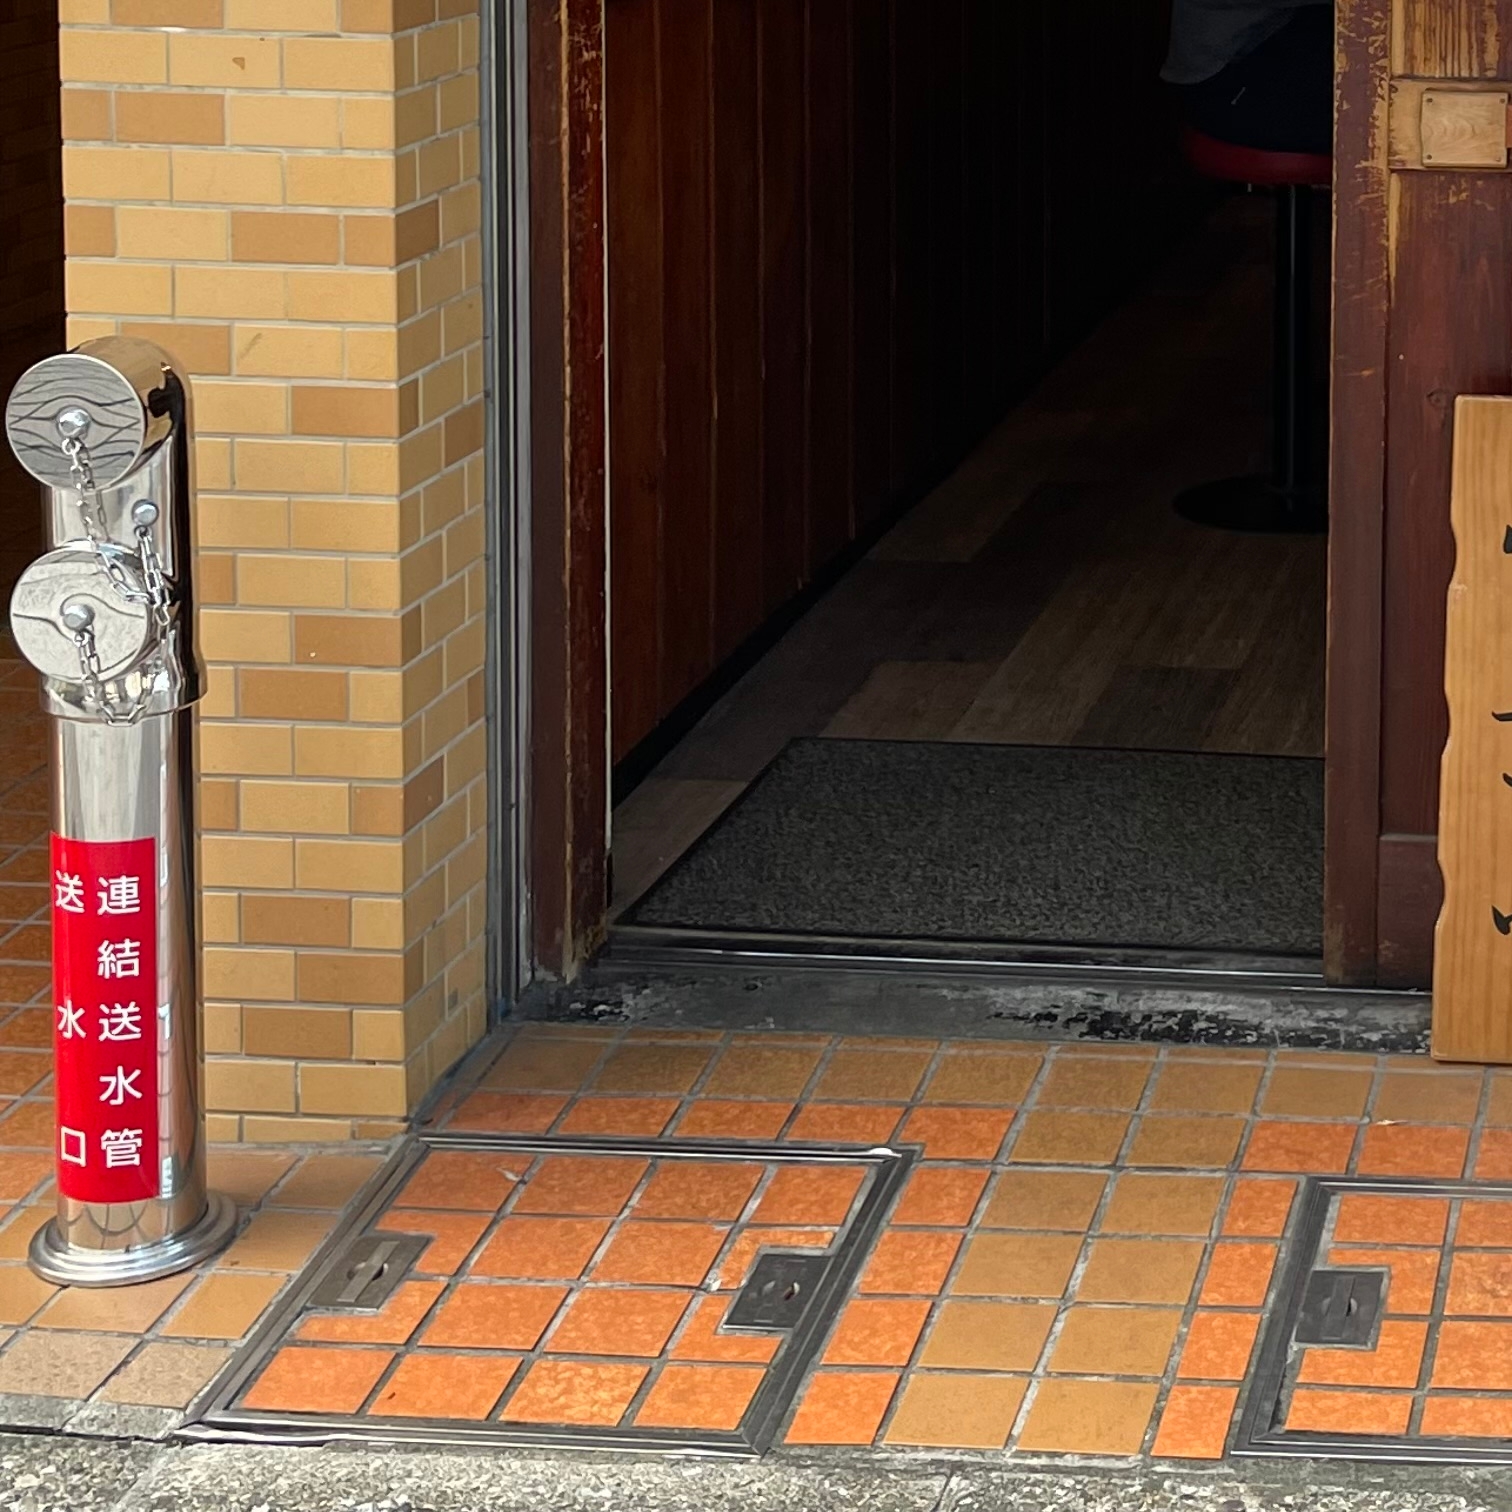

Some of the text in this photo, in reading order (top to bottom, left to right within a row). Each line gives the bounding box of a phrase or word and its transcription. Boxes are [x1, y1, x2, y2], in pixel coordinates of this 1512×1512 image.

[54, 869, 87, 1168] 送水口
[96, 875, 143, 1169] 連結送水管
